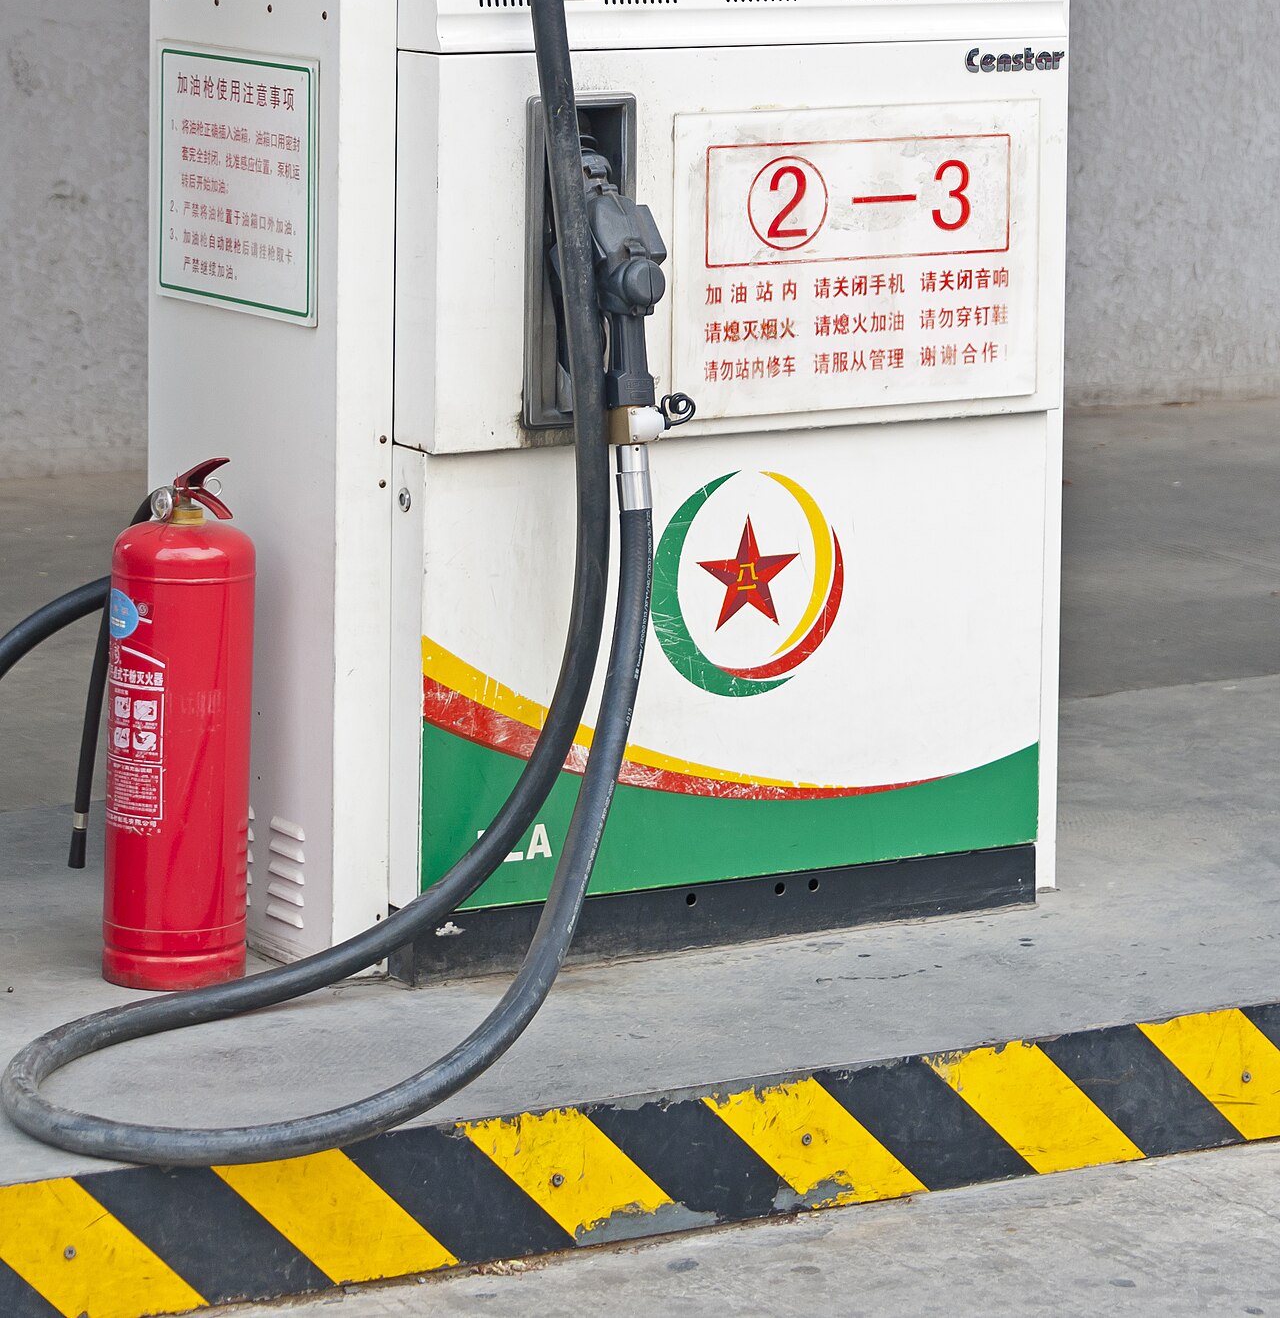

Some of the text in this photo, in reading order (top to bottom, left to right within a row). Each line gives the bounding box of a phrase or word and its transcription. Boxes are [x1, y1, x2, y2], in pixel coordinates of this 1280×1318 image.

[965, 47, 1065, 73] Censtar
[176, 71, 295, 112] 加油枪使用注意事项
[931, 159, 971, 232] 3
[704, 266, 1010, 307] 加油站内 请关闭手机 请关闭音响
[704, 303, 1009, 345] 请熄灭烟火 请熄火加油 请勿穿钉鞋
[703, 353, 797, 383] 请勿站内修车
[813, 347, 905, 375] 请服从管理
